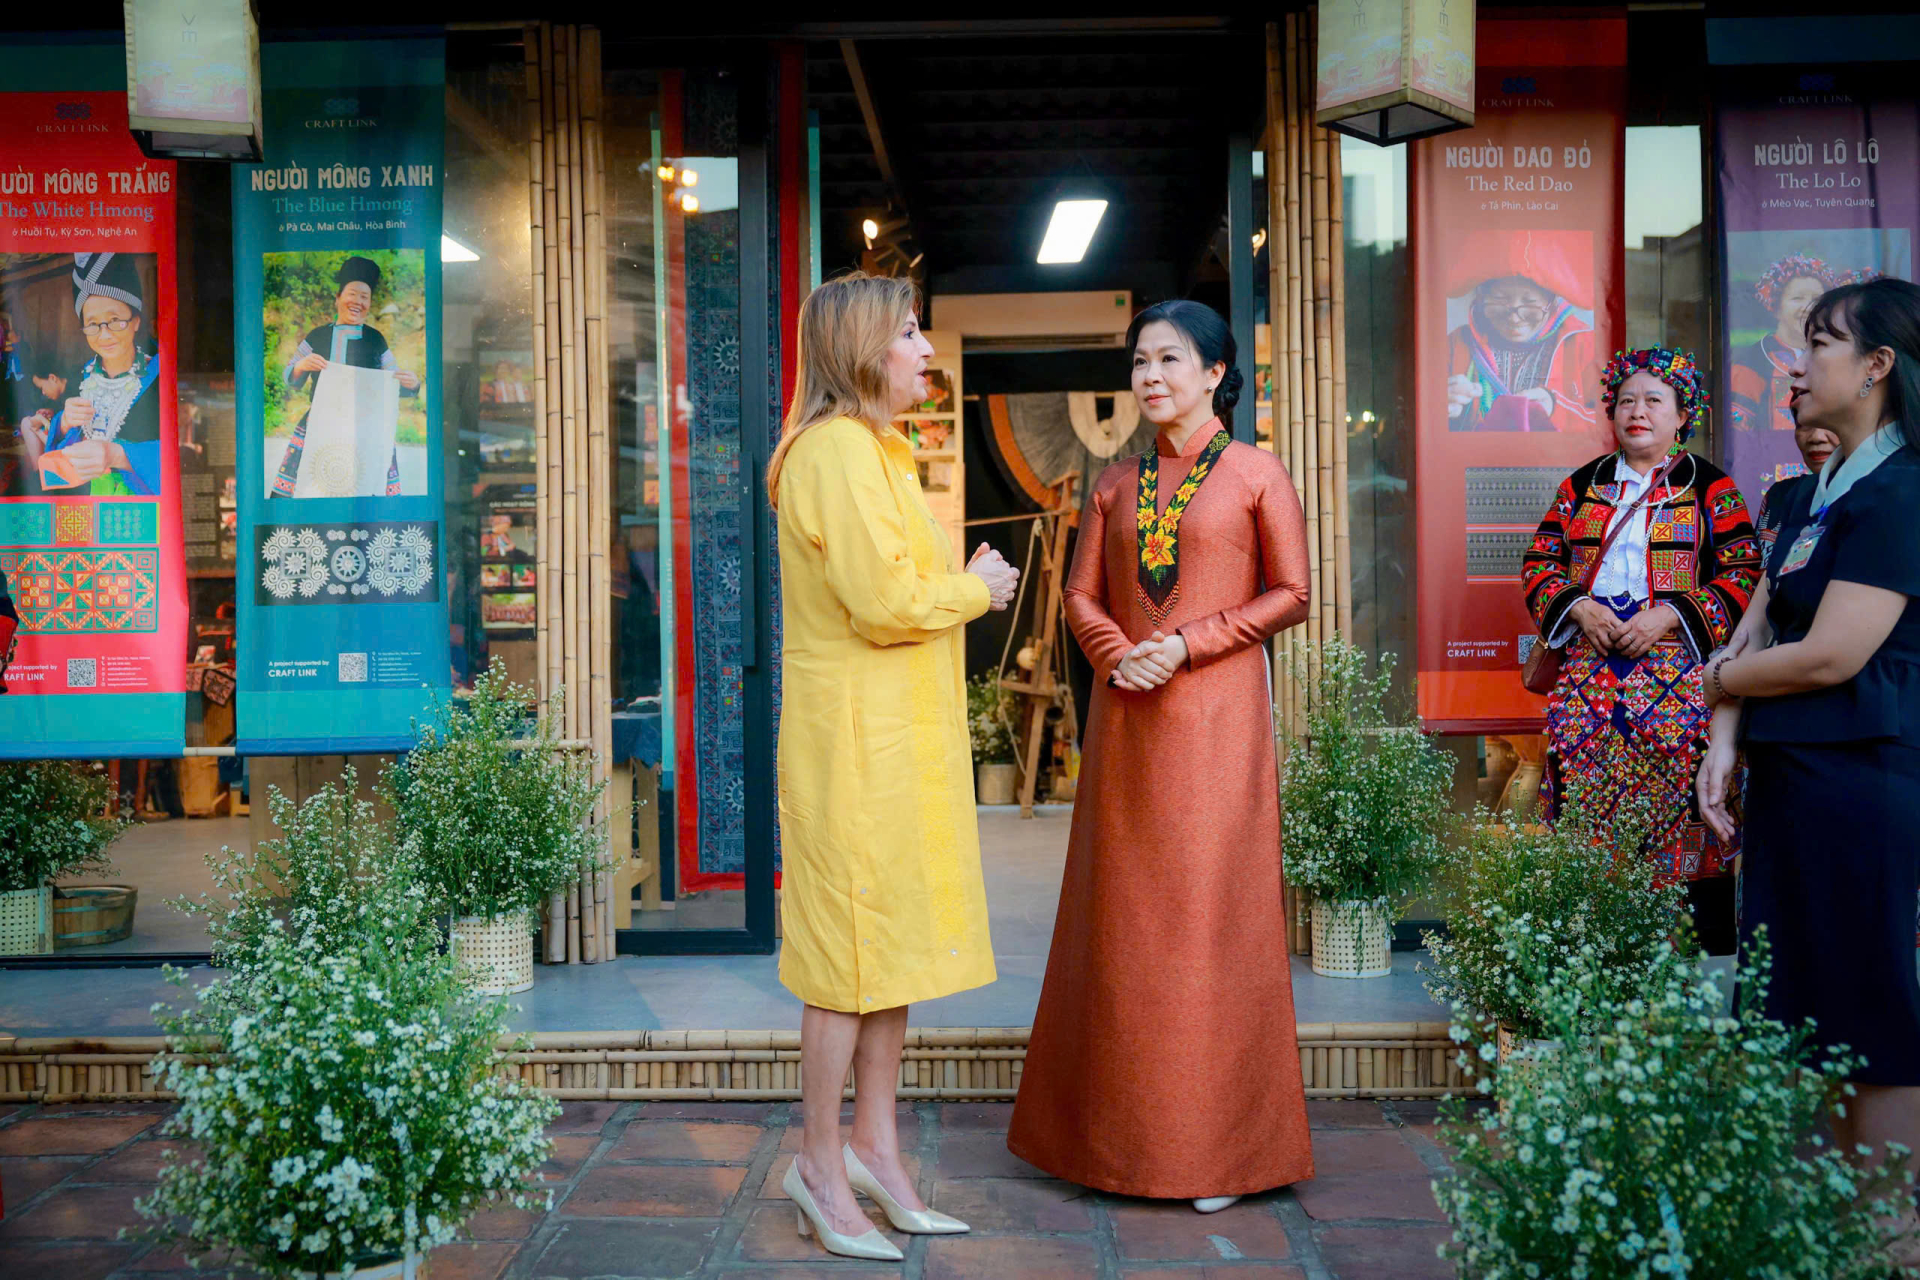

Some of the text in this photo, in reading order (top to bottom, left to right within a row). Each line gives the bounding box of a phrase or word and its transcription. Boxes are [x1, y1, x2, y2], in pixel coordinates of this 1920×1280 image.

[1482, 97, 1555, 108] CRAFT LINK
[1823, 94, 1853, 103] LINK
[36, 124, 109, 133] CRAFT LINK
[305, 119, 378, 129] CRAFT LINK
[1445, 138, 1591, 169] NGƯỜI DAO ĐỎ
[1754, 135, 1880, 166] NGƯỜI LÔ LÔ
[1, 162, 170, 194] ƯỜI MÔNG TRẮNG
[251, 160, 433, 191] NGƯỜI MÔNG XANH
[1775, 171, 1861, 189] The Lo Lo
[1465, 175, 1573, 192] The Red Dao
[272, 196, 413, 216] The Blue Hmong
[1544, 201, 1559, 211] Cai
[1769, 198, 1792, 208] Mèo
[1844, 197, 1875, 208] Quang
[0, 201, 154, 222] The White Hmong
[317, 220, 334, 231] Mai
[124, 227, 137, 236] An
[1447, 649, 1496, 658] CRAFT LINK
[4, 672, 45, 681] RAFT LINK
[268, 668, 317, 677] CRAFT LINK
